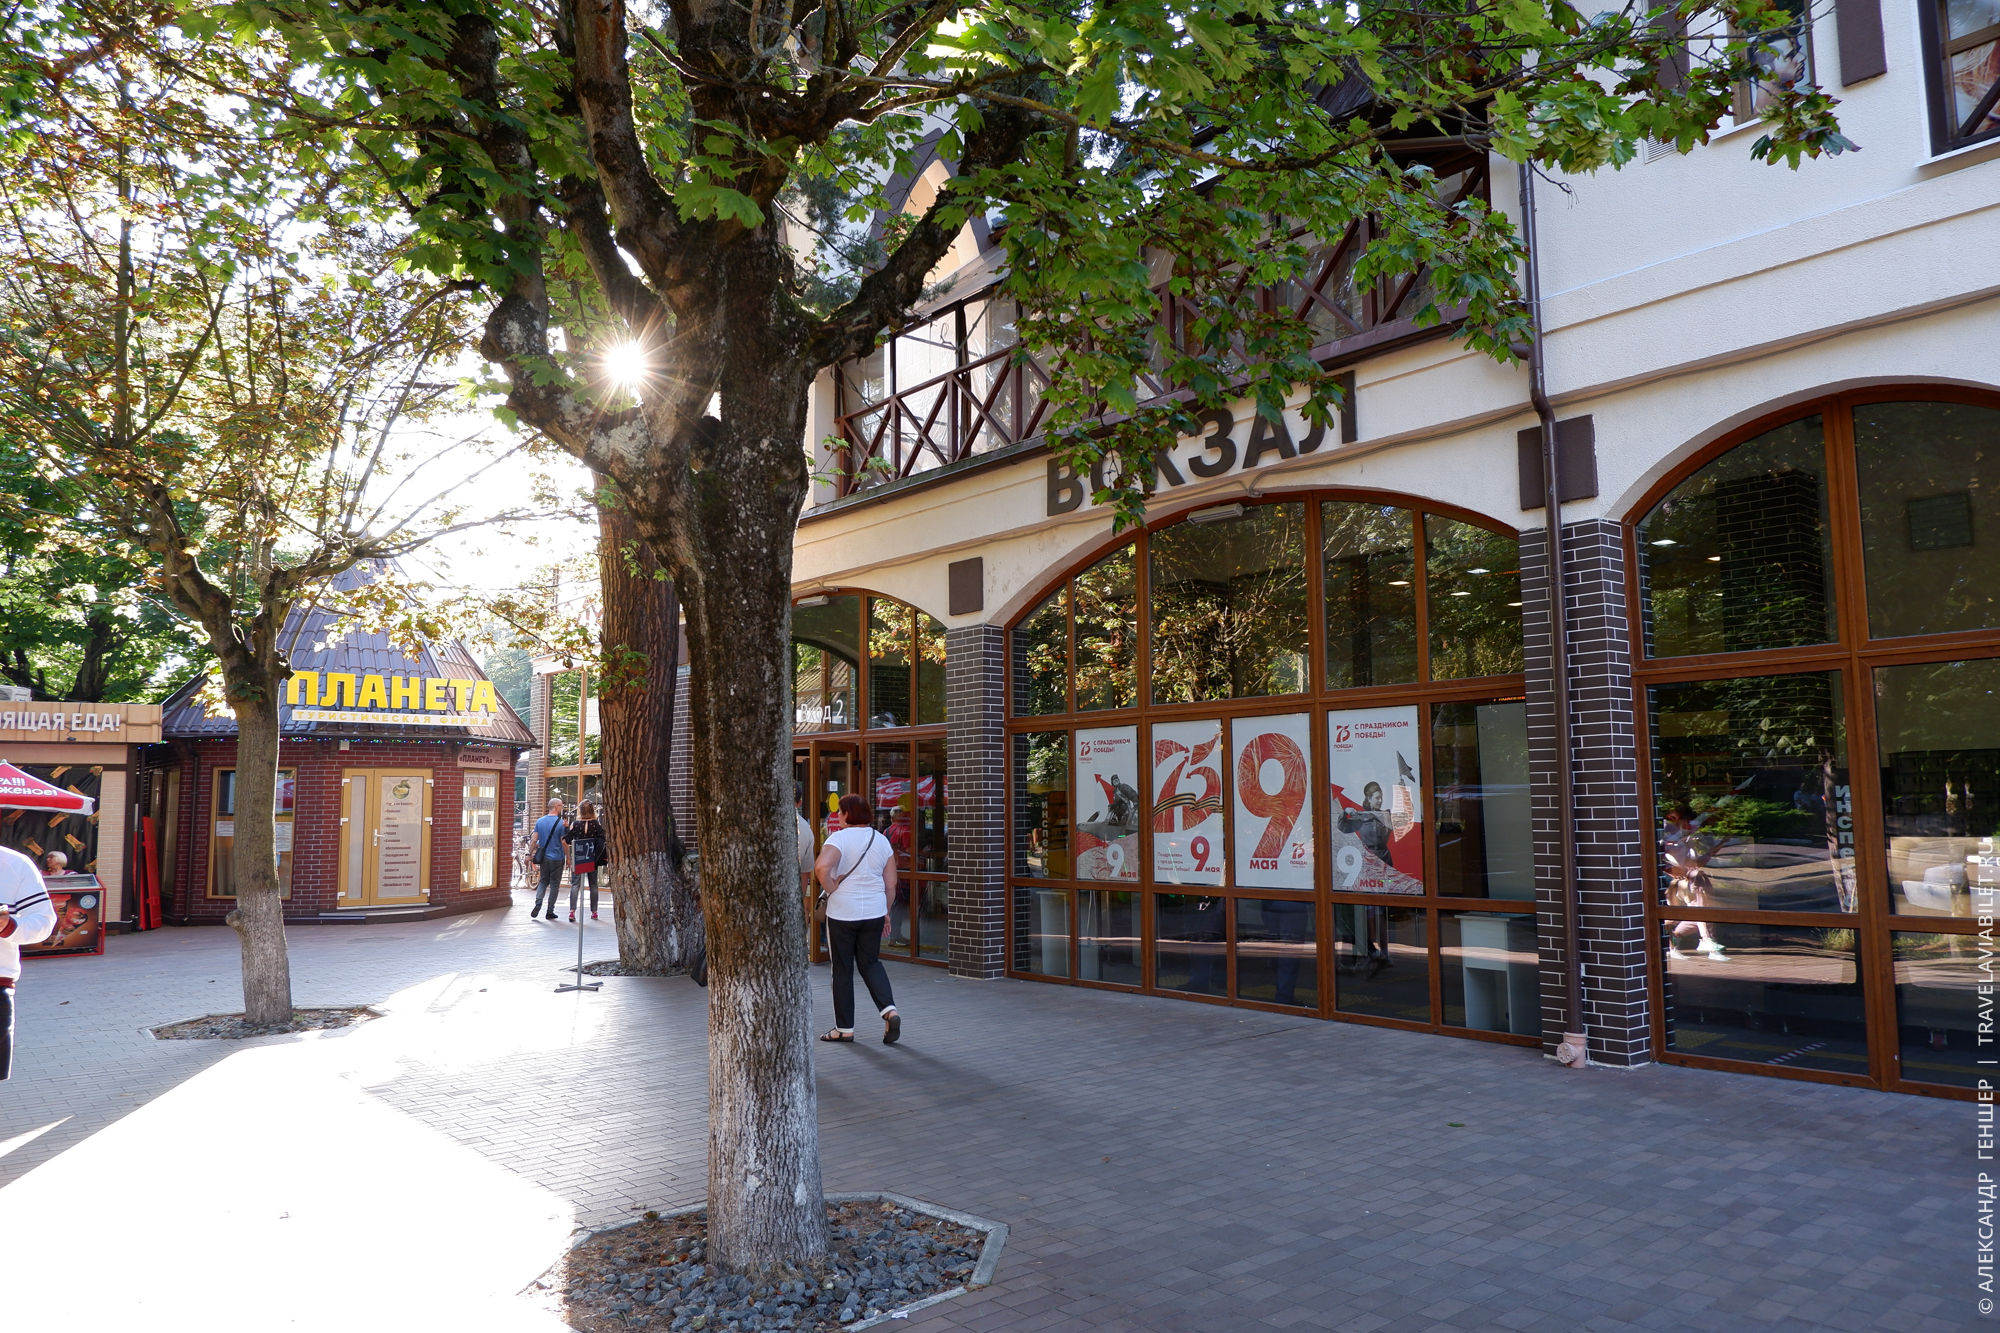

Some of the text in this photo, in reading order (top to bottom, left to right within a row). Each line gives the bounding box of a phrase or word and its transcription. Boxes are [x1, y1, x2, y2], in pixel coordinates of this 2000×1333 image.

[286, 670, 498, 713] ПЛАНЕТА
[0, 711, 121, 733] ЯЩАЯ ЕДА!
[296, 711, 489, 726] ТУРИСТИЧЕСКАЯ ФИРМА
[801, 699, 844, 724] Вход 2
[1354, 731, 1386, 739] ПОБЕДЫ!
[1360, 721, 1409, 730] ПРАЗДНИКОМ
[1097, 738, 1131, 746] ПРАЗДНИКОМ
[1237, 732, 1308, 858] 9
[1106, 843, 1125, 877] 9
[1191, 836, 1210, 872] 9
[1249, 859, 1279, 870] мая
[1336, 845, 1385, 888] 9 мая
